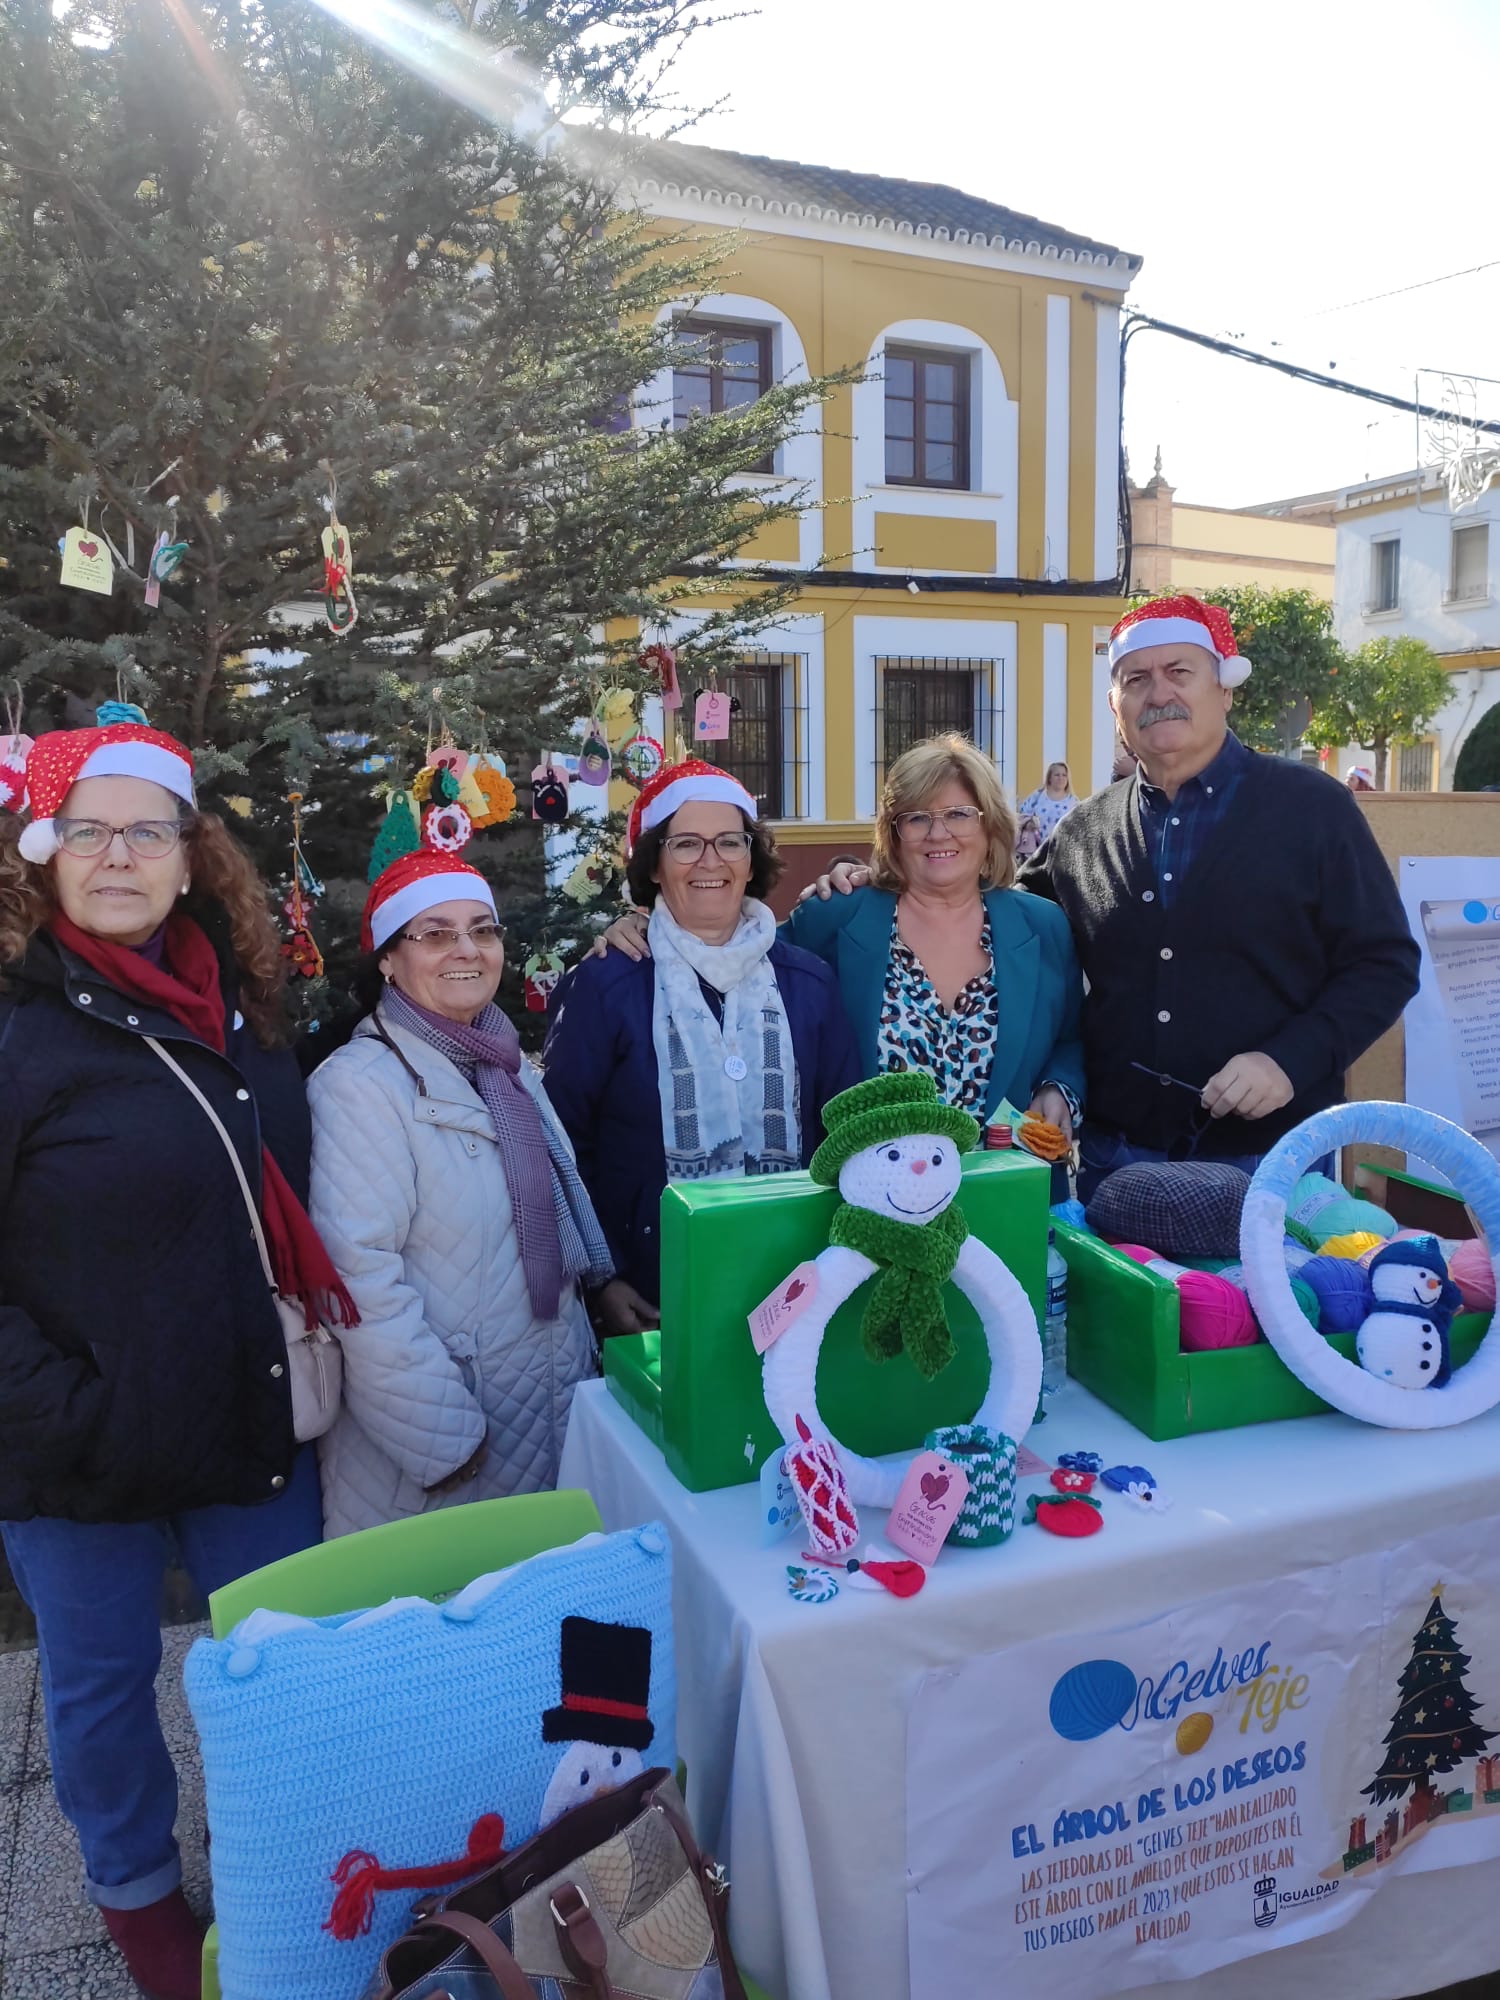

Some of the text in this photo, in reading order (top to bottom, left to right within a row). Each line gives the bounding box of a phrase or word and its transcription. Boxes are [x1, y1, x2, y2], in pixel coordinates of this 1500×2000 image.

[1146, 1640, 1272, 1720] Gelves
[1236, 1664, 1312, 1735] Teje
[1012, 1740, 1306, 1859] EL ÁRBOL DE LOS DESEOS
[1021, 1867, 1043, 1895] LAS
[1046, 1849, 1112, 1885] TEJEDORAS
[1115, 1842, 1134, 1869] DEL
[1239, 1785, 1297, 1825] REALIZADO
[1015, 1811, 1303, 1925] ESTE ÁRBOL CON EL ANHELO DE QUE DEPOSITES EN ÉL
[1023, 1845, 1294, 1953] TUS DESEOS PARA EL 2023 Y QUE ESTOS SE HAGAN
[1279, 1880, 1340, 1903] IGUALDAD
[1134, 1910, 1192, 1946] REALIDAD
